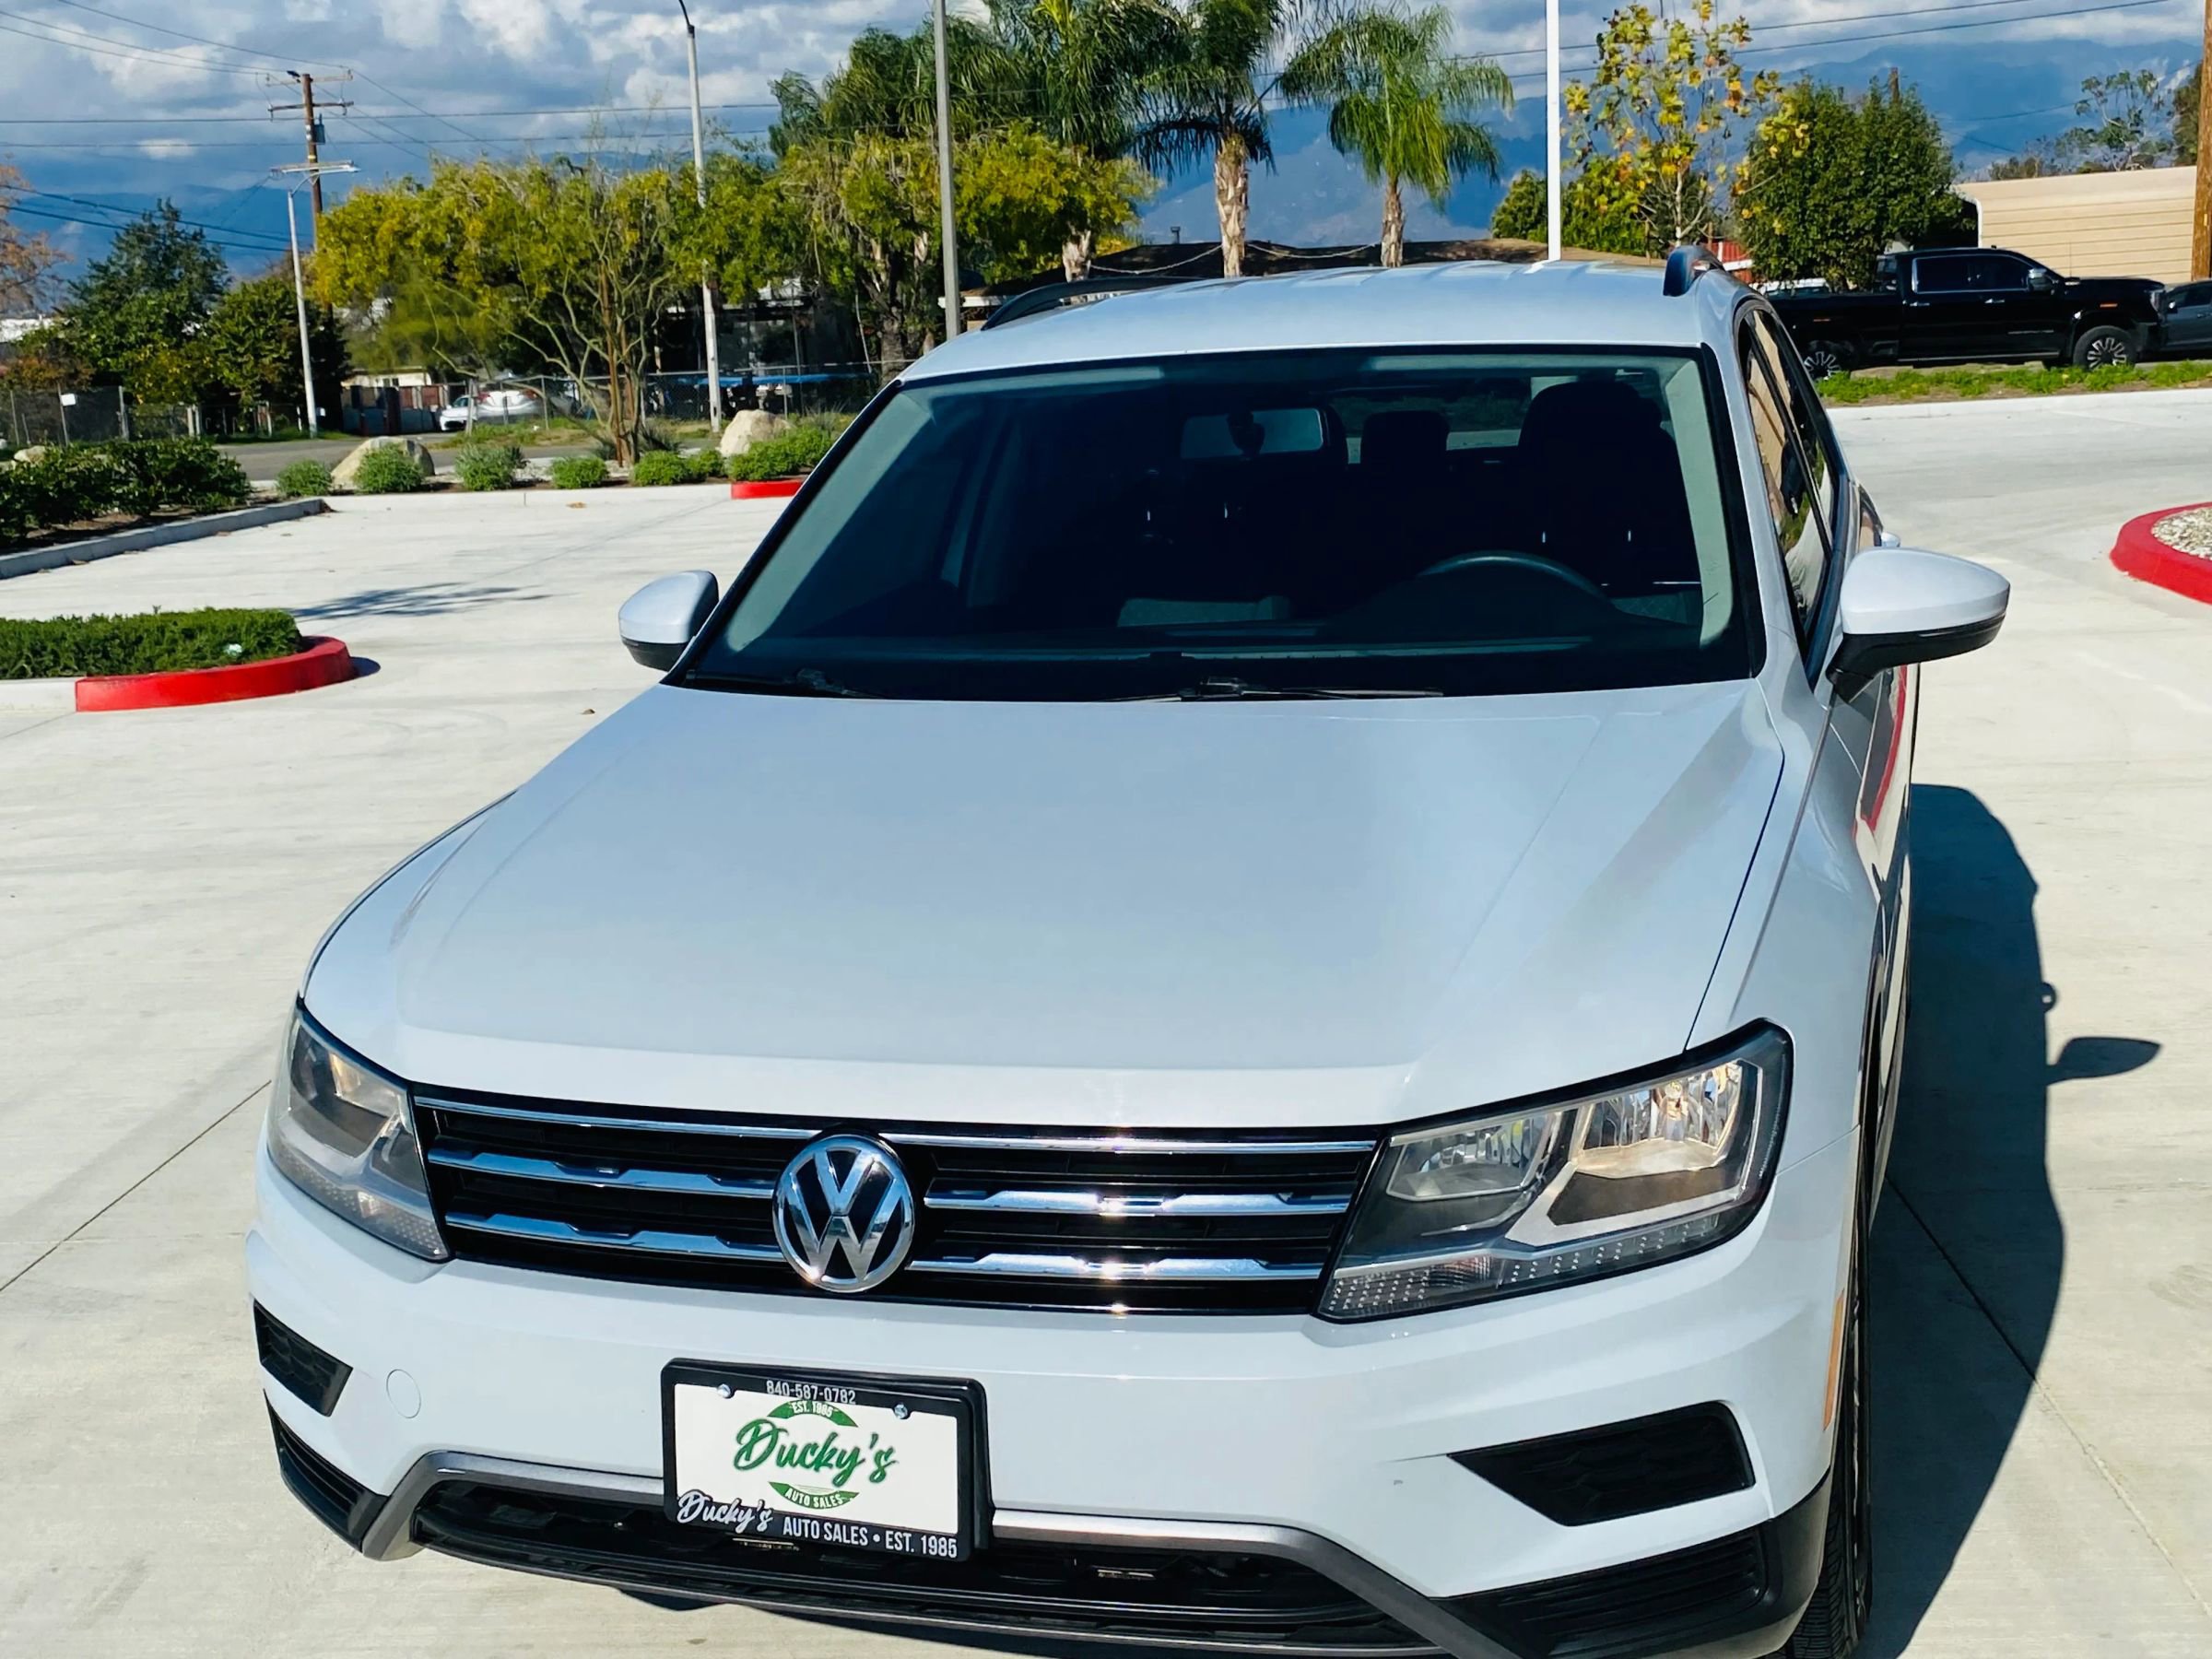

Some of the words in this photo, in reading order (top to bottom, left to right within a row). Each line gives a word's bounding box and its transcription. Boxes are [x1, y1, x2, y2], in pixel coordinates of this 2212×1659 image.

[766, 1380, 856, 1405] 840-587-0782
[791, 1400, 810, 1414] EST.
[733, 1418, 899, 1488] Ducky's
[784, 1488, 810, 1506] AUTO
[813, 1493, 843, 1509] SALES
[677, 1489, 774, 1534] Ducky's
[782, 1516, 820, 1540] AUTO
[823, 1522, 869, 1547] SALES
[885, 1530, 915, 1553] EST.
[921, 1535, 958, 1559] 1985
